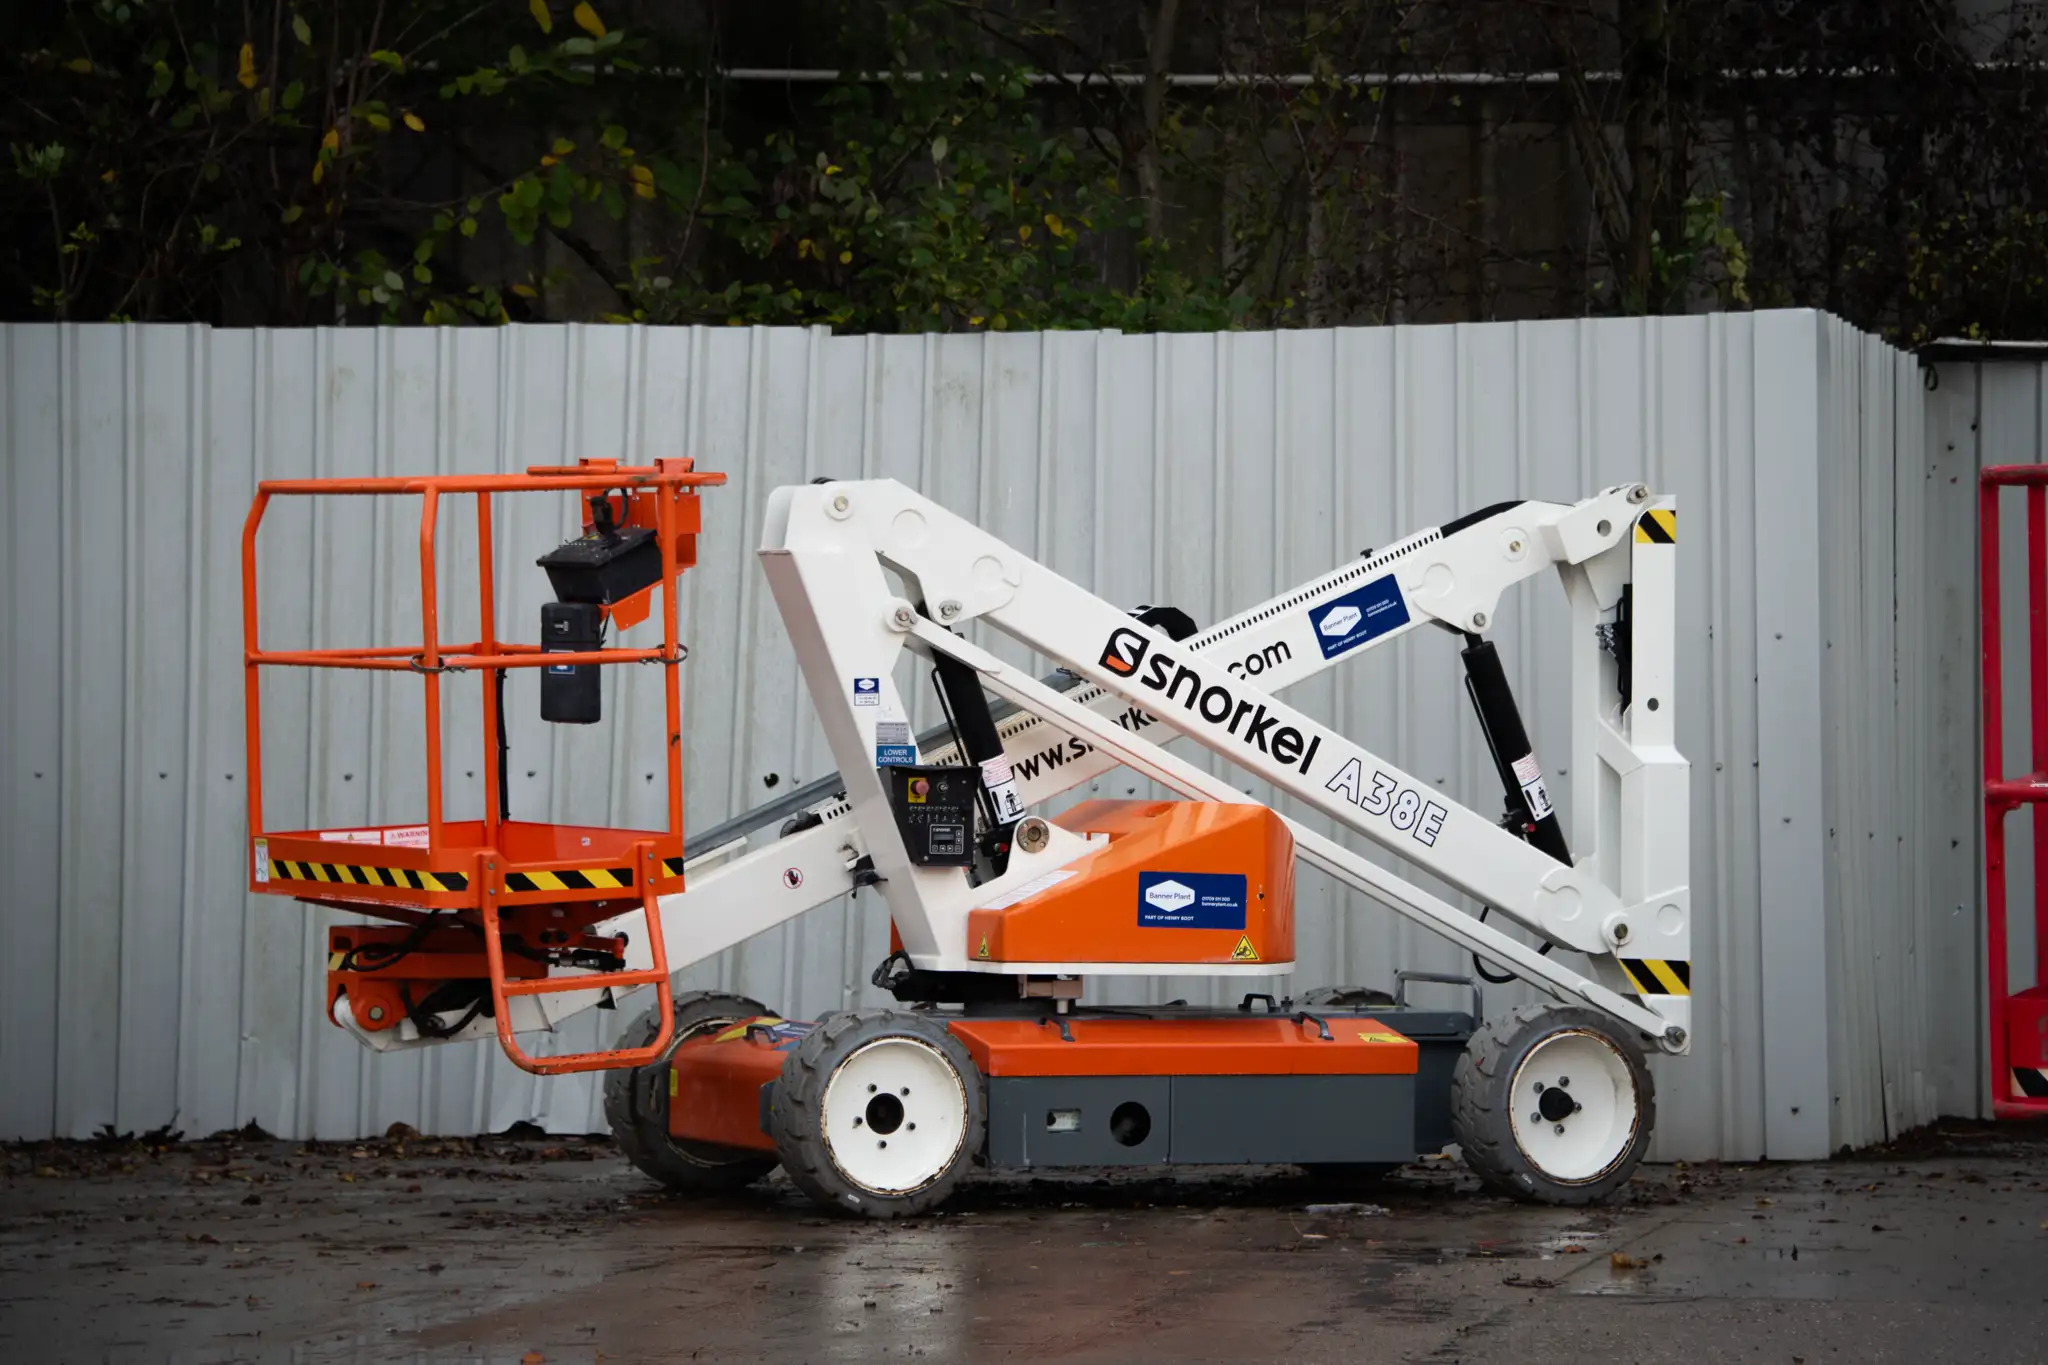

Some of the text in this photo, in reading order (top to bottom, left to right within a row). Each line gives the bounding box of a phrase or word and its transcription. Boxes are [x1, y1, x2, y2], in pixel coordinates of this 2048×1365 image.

[1323, 612, 1358, 631] Banner Plant
[1140, 653, 1322, 776] snorkel
[1325, 757, 1448, 848] A38E
[397, 830, 429, 839] WARNIN
[1173, 892, 1191, 900] Plant
